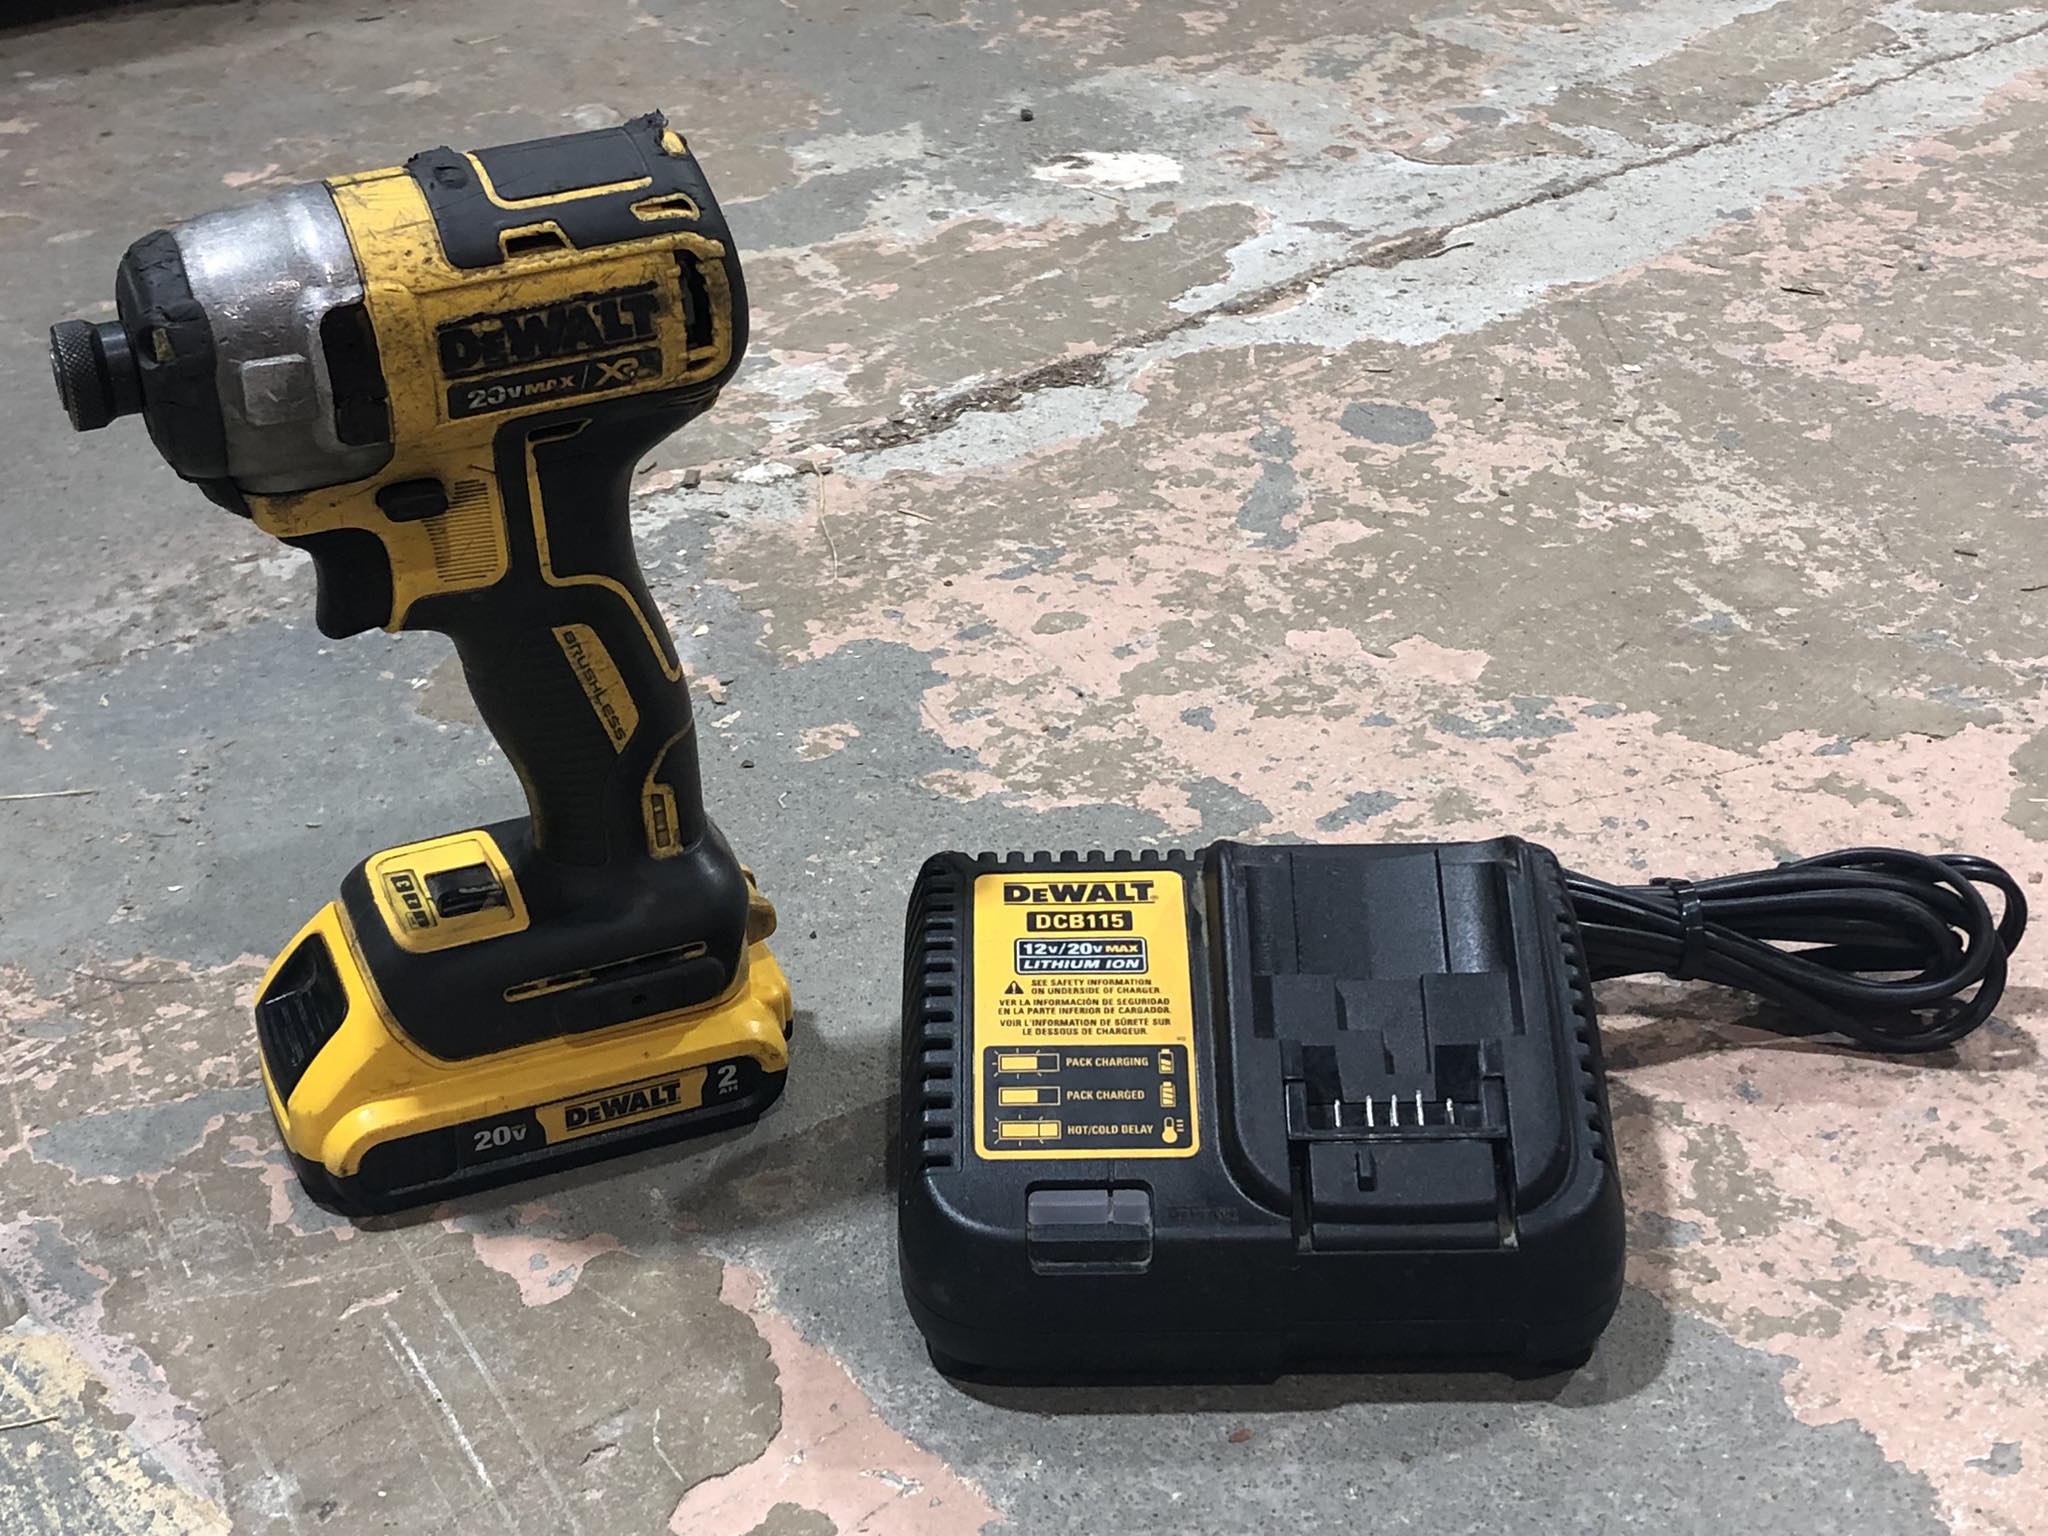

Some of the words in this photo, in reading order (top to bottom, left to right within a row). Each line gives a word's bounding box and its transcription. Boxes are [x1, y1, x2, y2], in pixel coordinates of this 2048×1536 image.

[563, 630, 627, 741] BRUSHLESS
[1004, 881, 1155, 905] DEWALT
[1036, 914, 1124, 928] DCB115
[1106, 944, 1138, 952] MAX
[1024, 959, 1100, 969] LITHIUM
[1106, 959, 1139, 969] ION
[1033, 998, 1099, 1006] INFORMACIÓN
[1066, 1057, 1092, 1067] PACK
[1095, 1057, 1149, 1066] CHARGING
[718, 1065, 738, 1088] 2
[1067, 1090, 1093, 1100] PACK
[1096, 1090, 1145, 1099] CHARGED
[565, 1080, 681, 1131] DEWALT
[1067, 1125, 1118, 1135] HOT/COLD
[1121, 1125, 1153, 1134] DELAY
